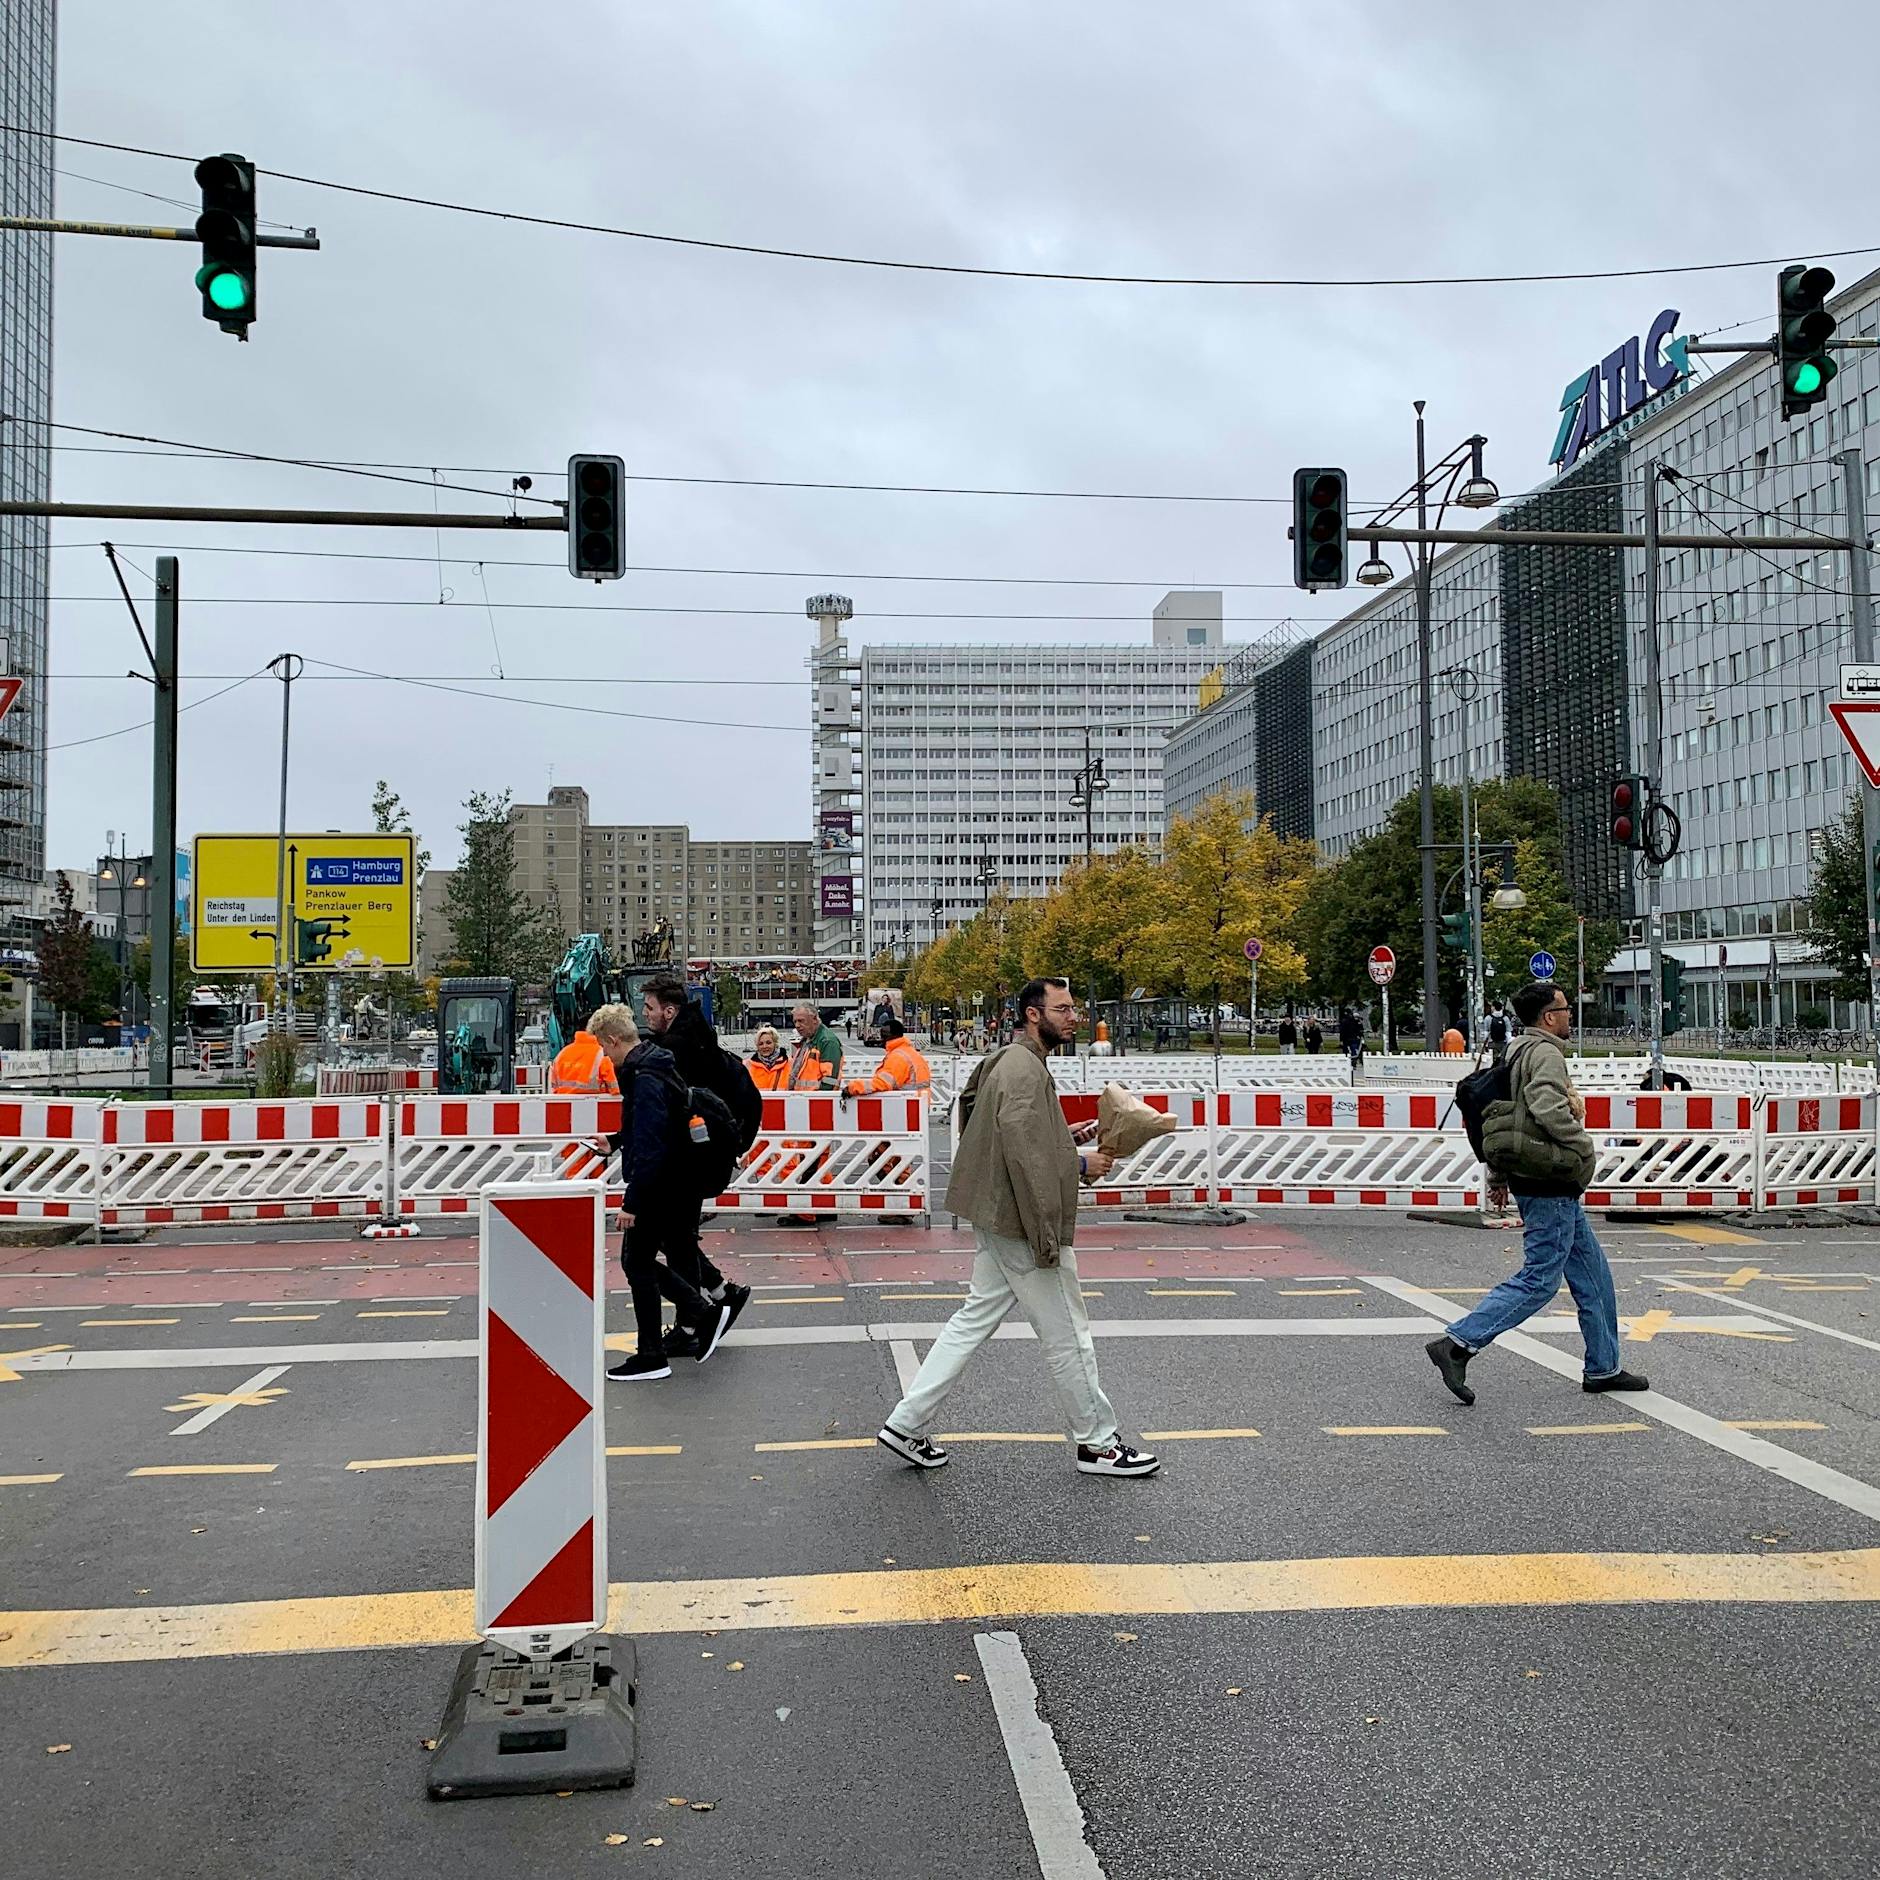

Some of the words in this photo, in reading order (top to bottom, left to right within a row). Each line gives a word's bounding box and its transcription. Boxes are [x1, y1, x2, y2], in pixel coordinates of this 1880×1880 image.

[352, 861, 401, 872] Hamburg
[352, 873, 399, 883] Prenzlau
[305, 889, 346, 898] Pankow
[207, 901, 246, 911] Reichstag
[305, 901, 363, 911] Prenzlauer
[367, 901, 393, 912] Berg
[207, 914, 228, 923] Unter
[232, 914, 247, 922] den
[250, 913, 276, 922] Linden
